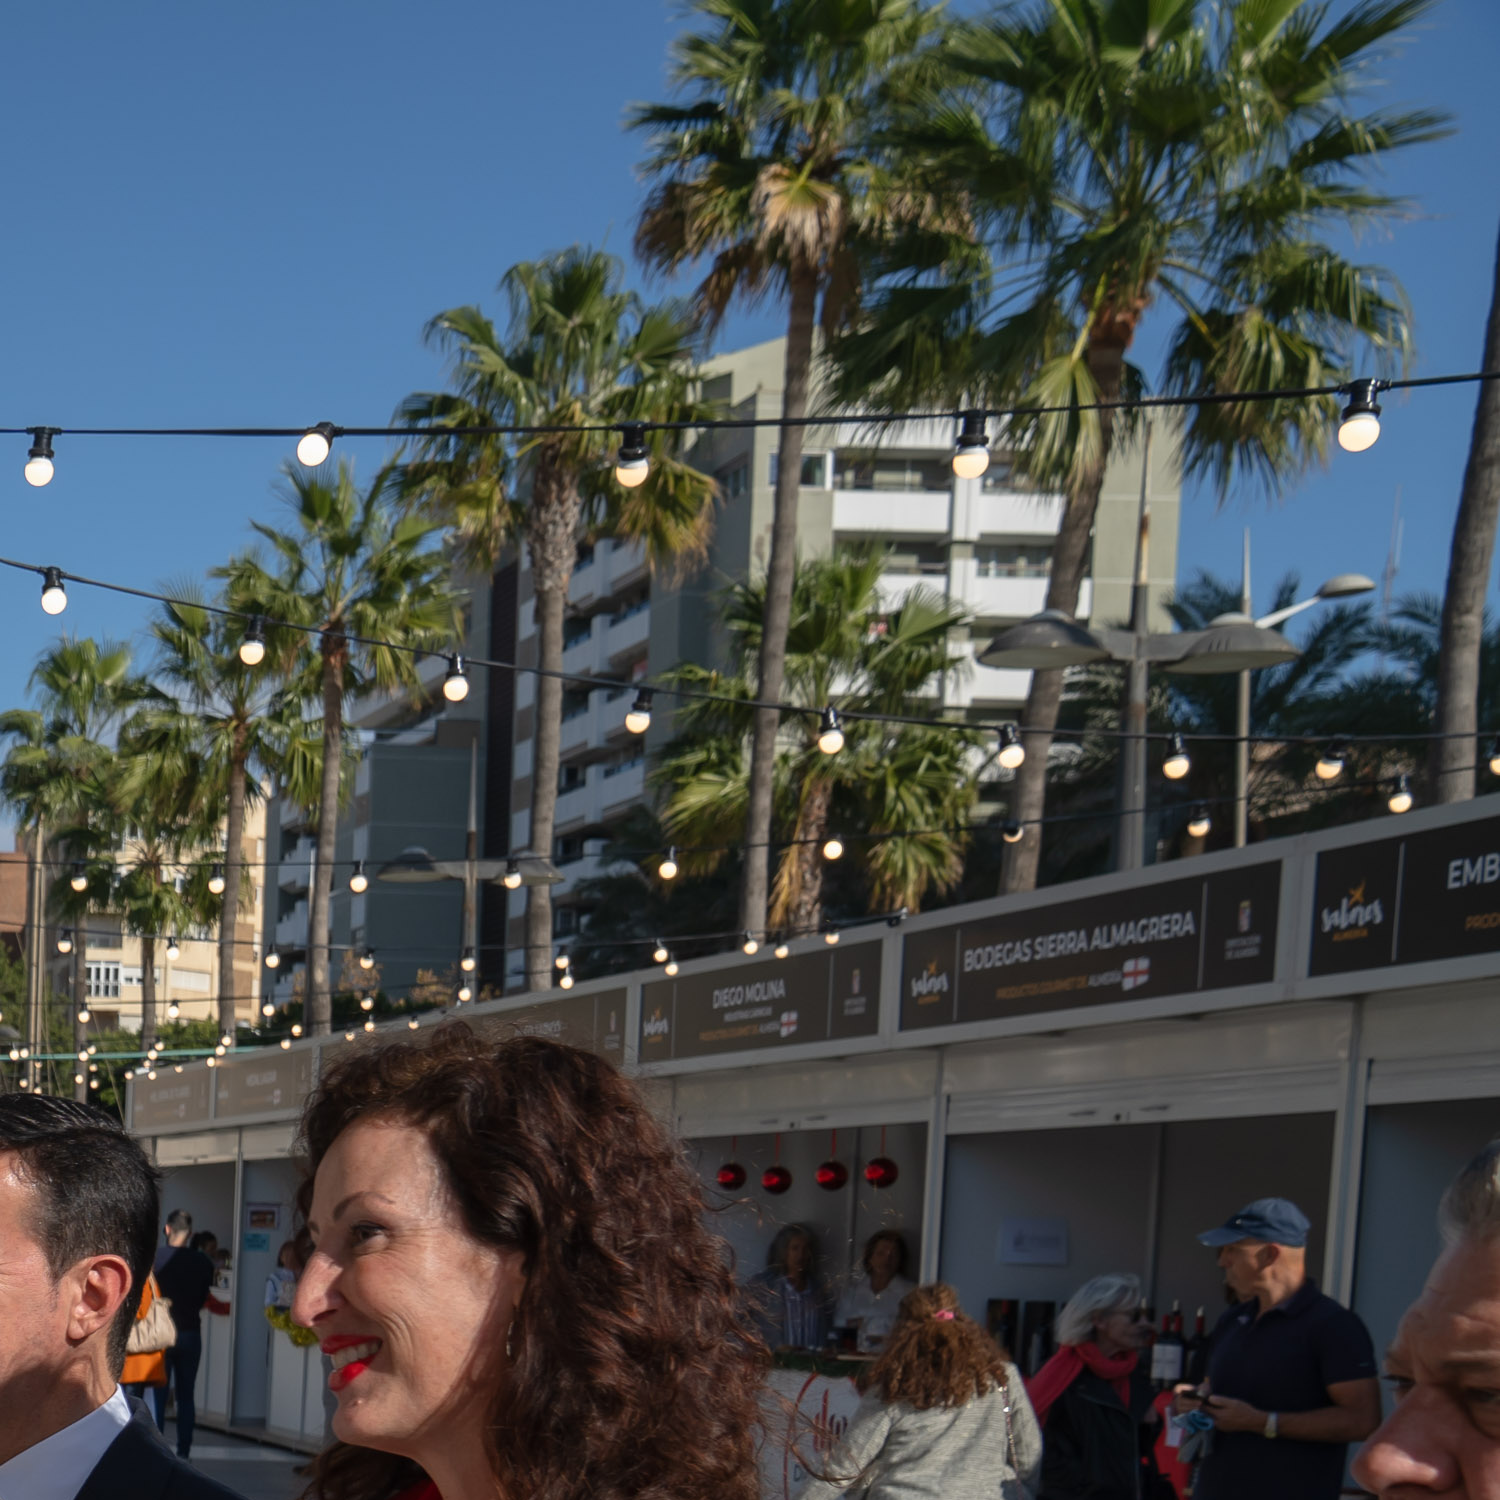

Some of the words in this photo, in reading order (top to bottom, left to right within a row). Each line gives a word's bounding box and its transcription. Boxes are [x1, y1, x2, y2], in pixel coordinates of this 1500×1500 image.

[1447, 852, 1500, 890] EMB
[963, 935, 1033, 973] BODEGAS
[1033, 928, 1090, 960] SIERRA
[1090, 910, 1197, 949] ALMAGRERA
[712, 985, 744, 1010] DIEGO
[745, 977, 787, 1003] MOLINA
